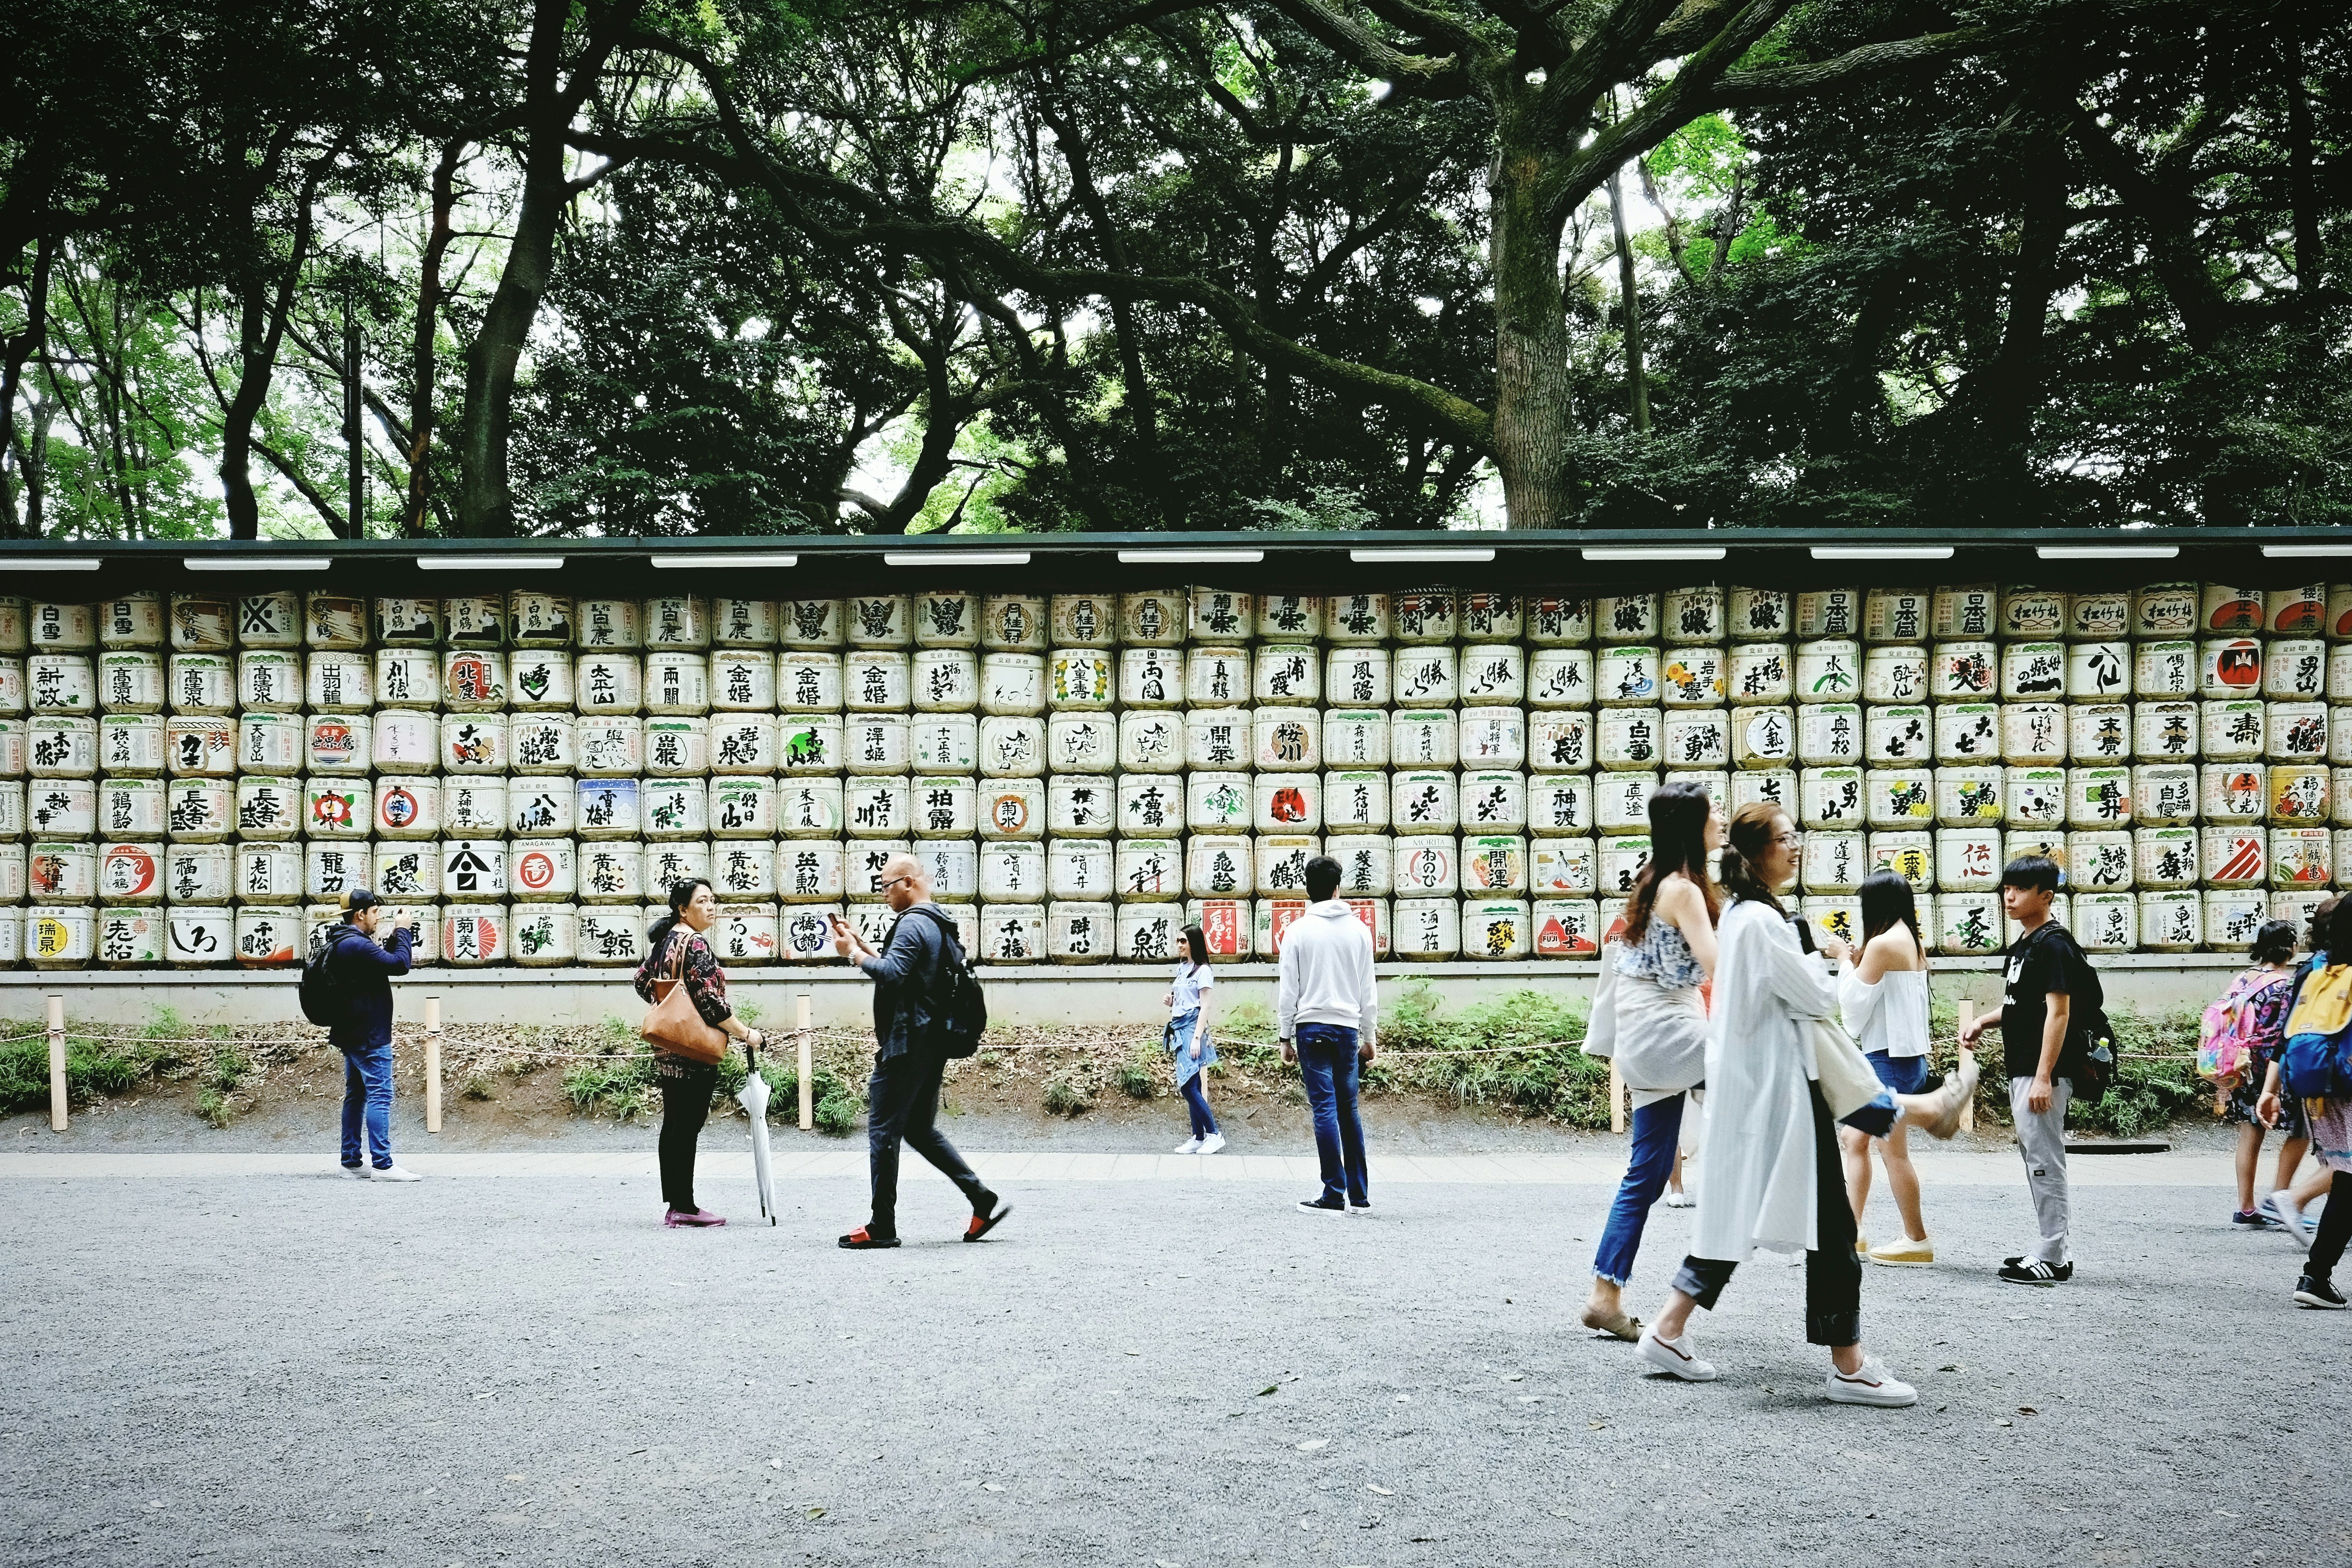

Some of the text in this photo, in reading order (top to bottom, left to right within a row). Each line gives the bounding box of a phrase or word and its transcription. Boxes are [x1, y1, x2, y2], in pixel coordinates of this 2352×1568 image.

[42, 605, 61, 639] 白雪
[113, 603, 134, 634] 白雪
[391, 601, 405, 630] 白鶴
[458, 601, 472, 630] 白鶴
[528, 600, 542, 629] 白鶴
[659, 607, 683, 642] 白鹿
[729, 604, 752, 639] 白鹿
[1004, 603, 1023, 644] 月桂冠
[1074, 600, 1093, 641] 月桂冠
[1141, 599, 1160, 639] 月桂冠
[1825, 594, 1849, 634] 日本盛
[1894, 598, 1917, 638] 日本盛
[1963, 594, 1986, 634] 日本盛
[2018, 603, 2060, 623] 松竹梅
[2082, 602, 2126, 622] 松竹梅
[2147, 599, 2193, 618] 松竹梅
[591, 610, 614, 645] 白鹿
[37, 667, 67, 707] 新政
[322, 664, 341, 704] 出羽鶴
[457, 663, 478, 701] 北鹿
[591, 664, 614, 704] 太平山
[727, 664, 753, 703] 金婚
[796, 667, 821, 706] 金婚
[862, 666, 888, 704] 金婚
[2296, 656, 2319, 693] 男山
[181, 734, 202, 766] 力士
[1277, 724, 1303, 760] 桜川
[1630, 721, 1651, 761] 白菊
[517, 794, 557, 831] 八海山
[587, 790, 617, 826] 雪中梅
[927, 790, 955, 830] 柏露
[1002, 802, 1019, 827] 菊水
[1821, 781, 1858, 821] 男山
[249, 857, 268, 893] 老松
[321, 852, 346, 893] 龍力
[492, 856, 503, 889] 月の桂
[1422, 848, 1436, 887] ねのひ
[1489, 850, 1509, 889] 開運
[1903, 849, 1921, 881] 一本義
[39, 924, 56, 953] 瑞泉
[170, 920, 217, 955] しろ
[456, 917, 479, 959] 菊美人
[799, 916, 817, 952] 梅錦
[1001, 920, 1024, 958] 千福
[1561, 916, 1579, 949] 富士
